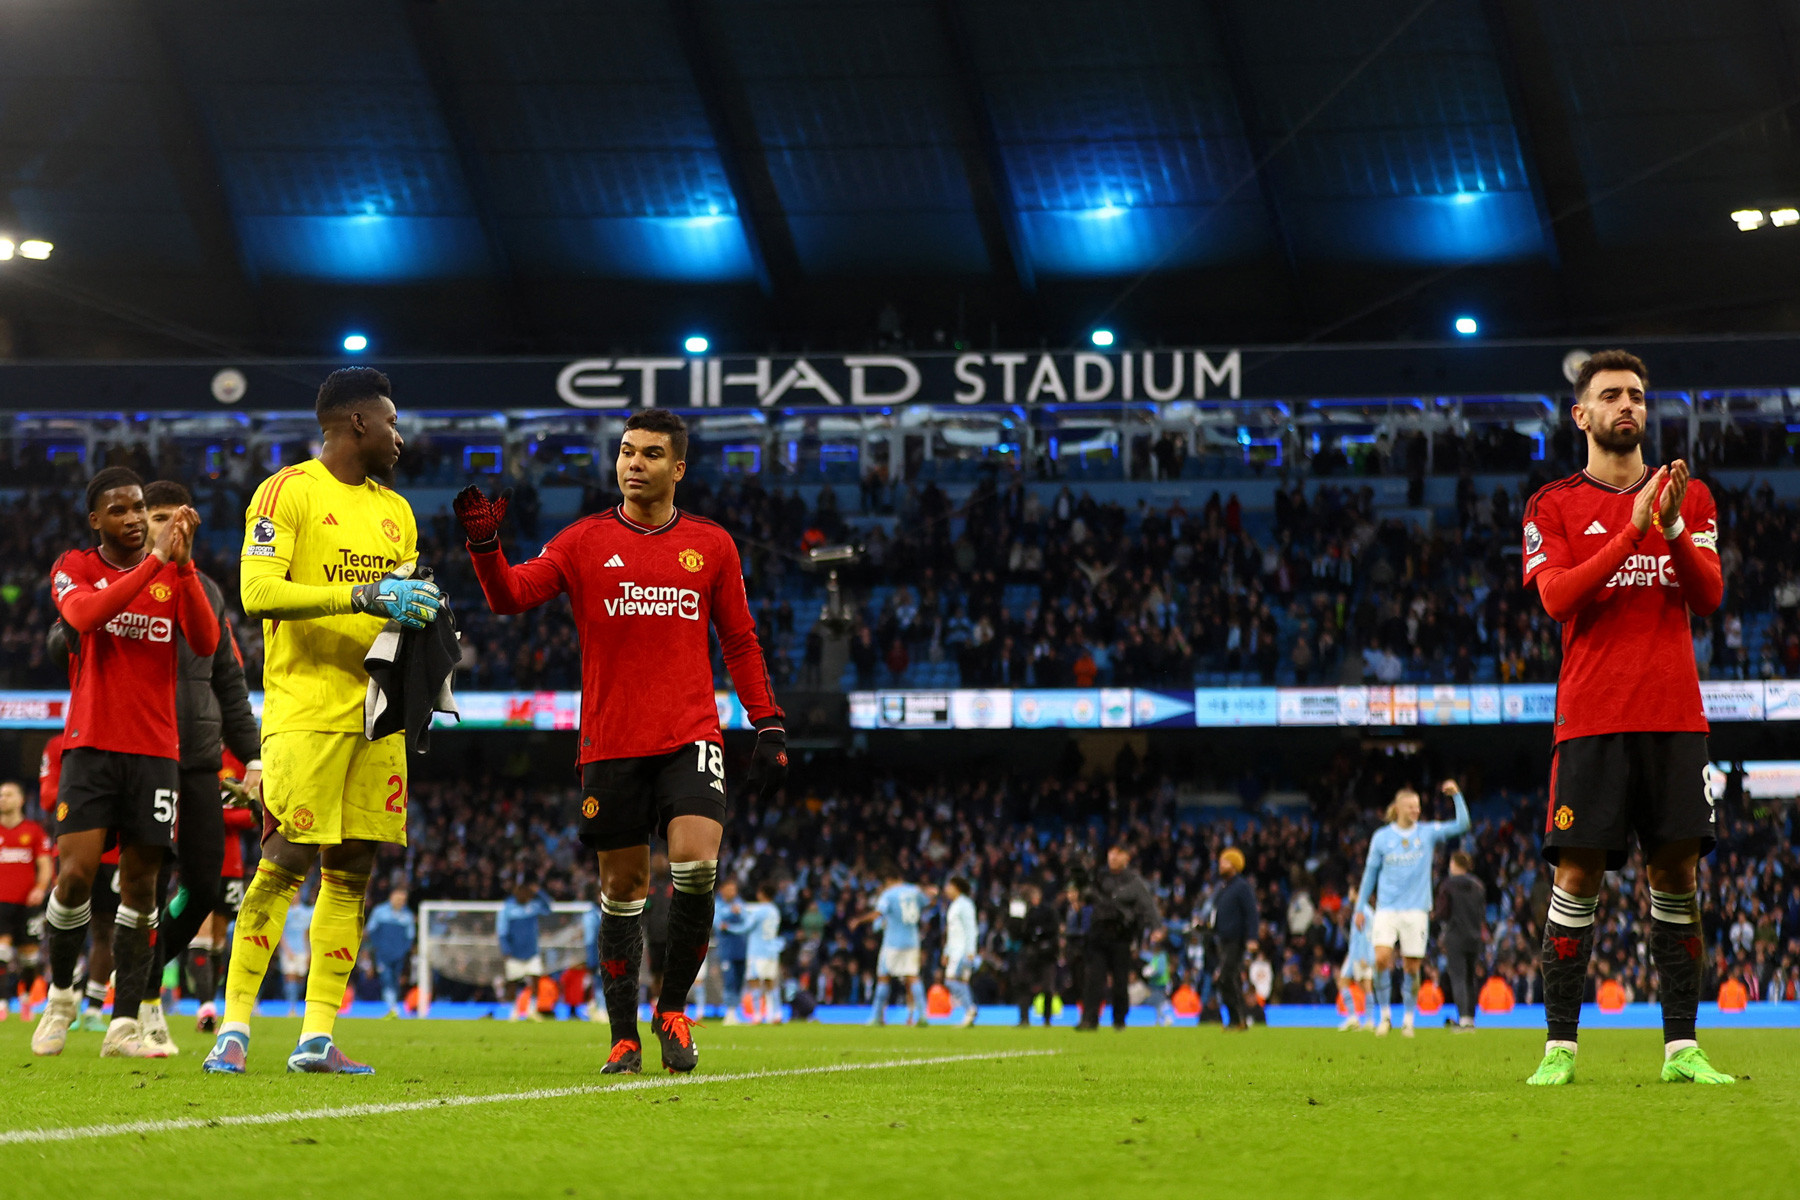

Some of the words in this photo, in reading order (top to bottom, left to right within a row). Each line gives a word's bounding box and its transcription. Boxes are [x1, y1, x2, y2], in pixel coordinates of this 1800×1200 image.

[556, 357, 922, 409] ETIHAD
[954, 350, 1242, 404] STADIUM
[1620, 554, 1657, 571] am
[1605, 571, 1658, 588] ewer
[618, 582, 678, 601] Team
[603, 597, 677, 617] Viewer
[110, 611, 149, 627] eam
[105, 621, 148, 640] ewer
[694, 740, 725, 780] 18
[385, 774, 408, 814] 2
